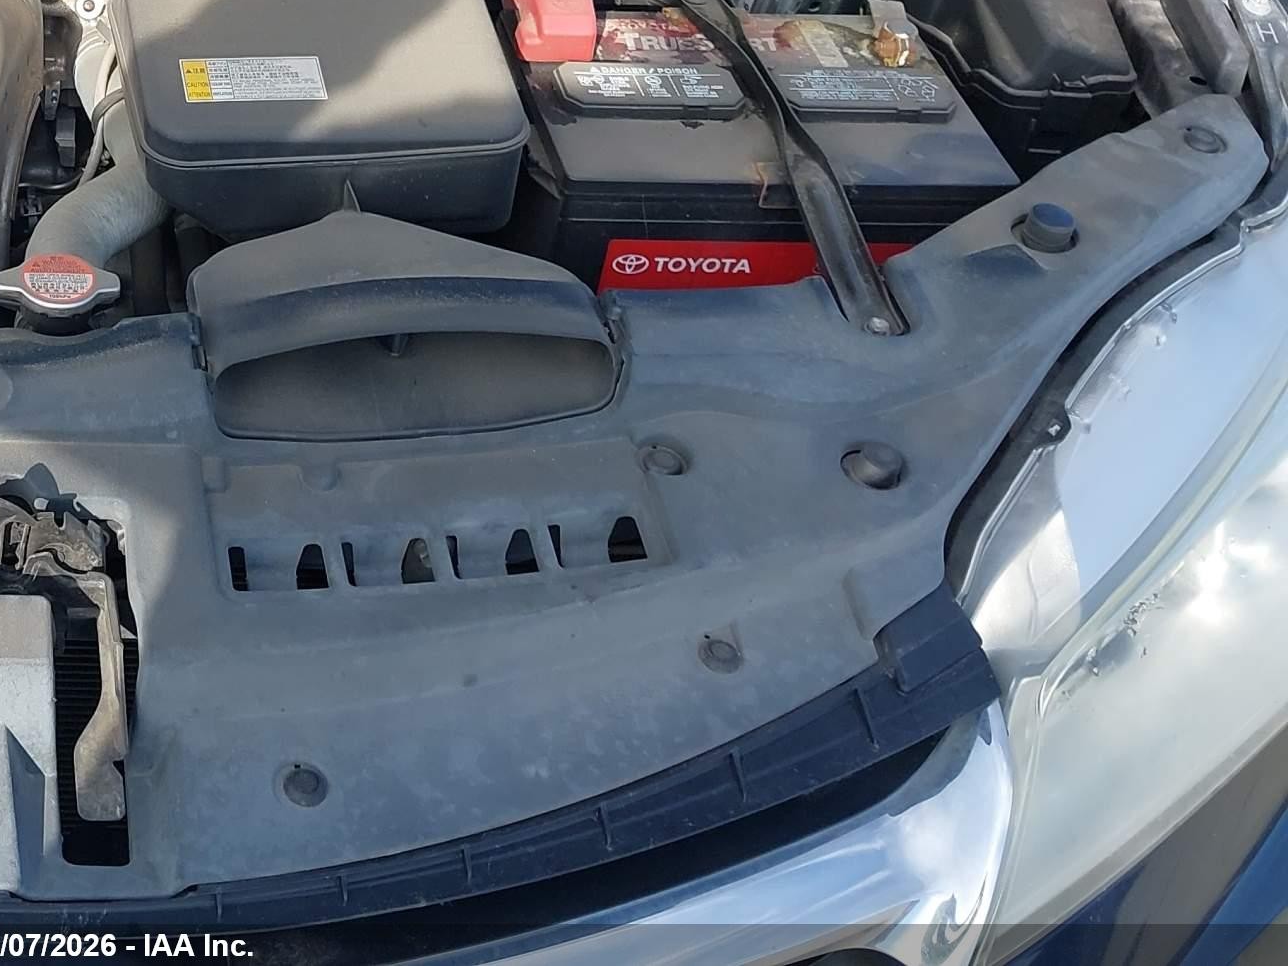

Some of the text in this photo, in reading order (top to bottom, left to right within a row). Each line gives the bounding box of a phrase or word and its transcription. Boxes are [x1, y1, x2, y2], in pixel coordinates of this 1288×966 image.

[601, 66, 646, 74] DANGER
[657, 67, 698, 75] POISON
[653, 256, 751, 274] TOYOTA
